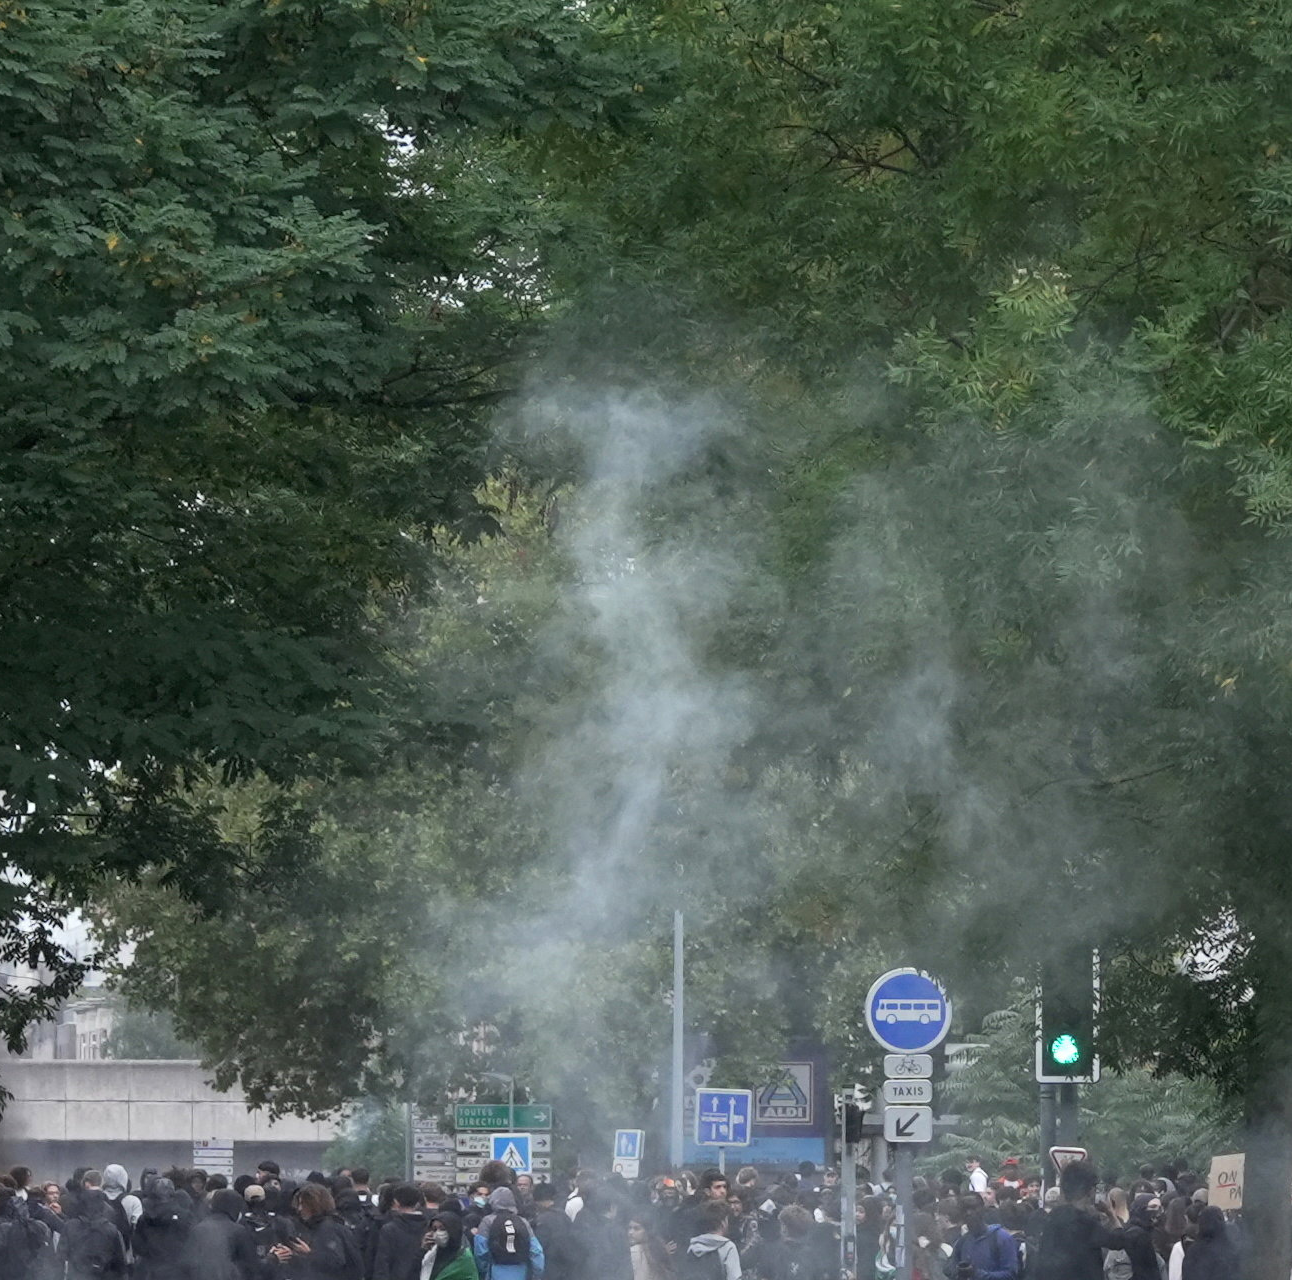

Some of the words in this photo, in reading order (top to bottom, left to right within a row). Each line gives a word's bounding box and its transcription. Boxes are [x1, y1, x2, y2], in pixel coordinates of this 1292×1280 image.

[893, 1087, 924, 1096] TAXIS
[459, 1108, 494, 1116] TOUTES
[764, 1107, 803, 1117] ALDI
[459, 1117, 509, 1126] DIRECTION
[1218, 1171, 1238, 1185] ON
